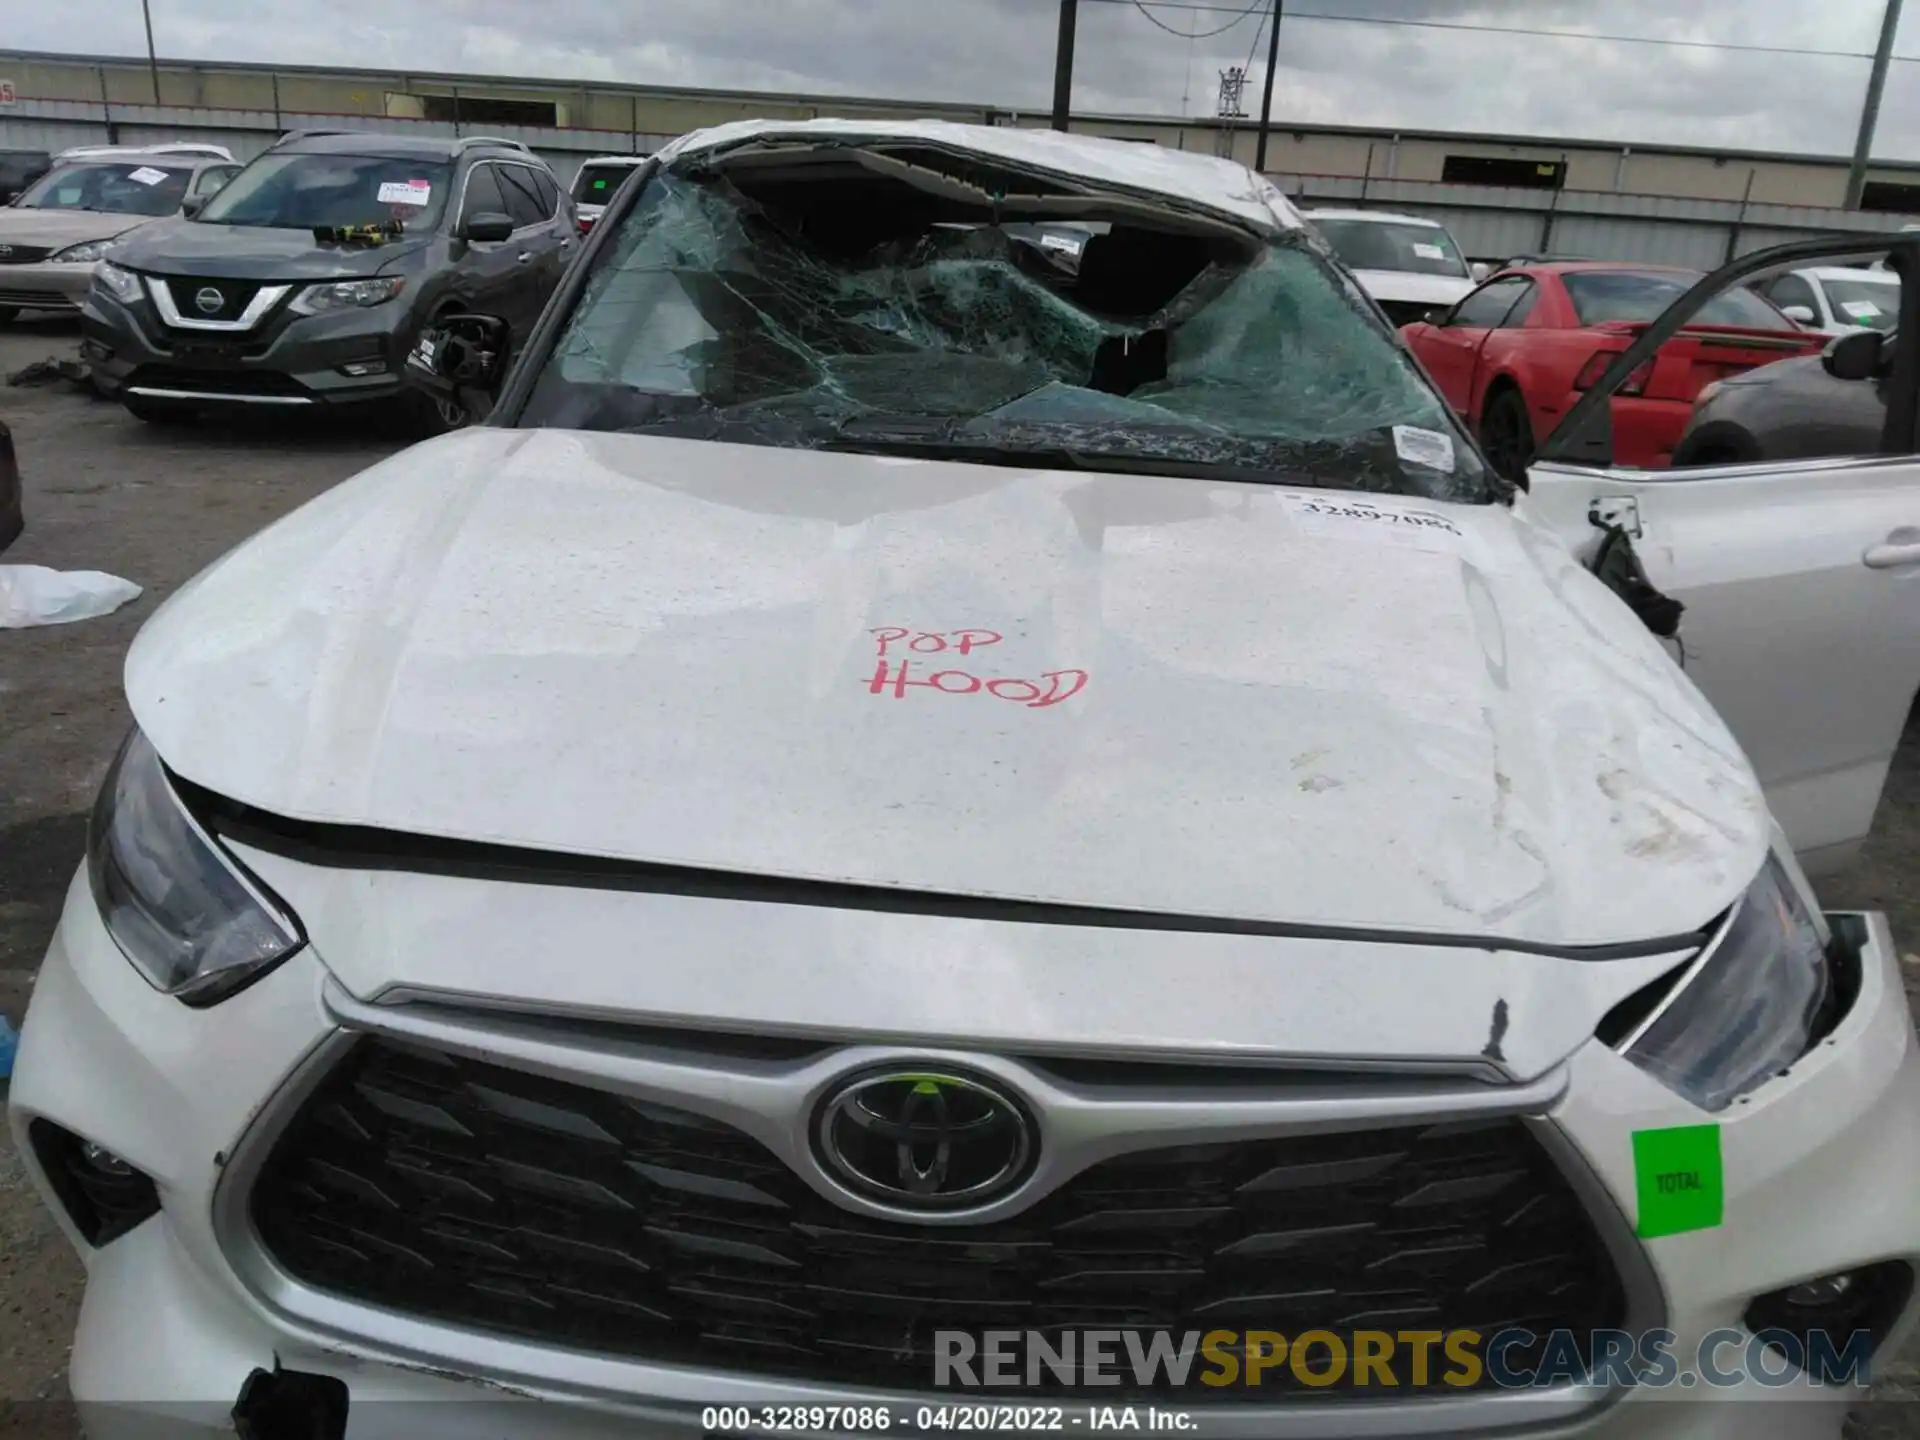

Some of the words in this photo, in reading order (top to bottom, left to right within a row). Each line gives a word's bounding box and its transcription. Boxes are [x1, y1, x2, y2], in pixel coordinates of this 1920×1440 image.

[0, 83, 14, 101] 5
[1302, 503, 1462, 536] 32897086
[867, 626, 1003, 656] POP
[861, 659, 1088, 707] HOOD
[1655, 1171, 1702, 1194] TOTAL
